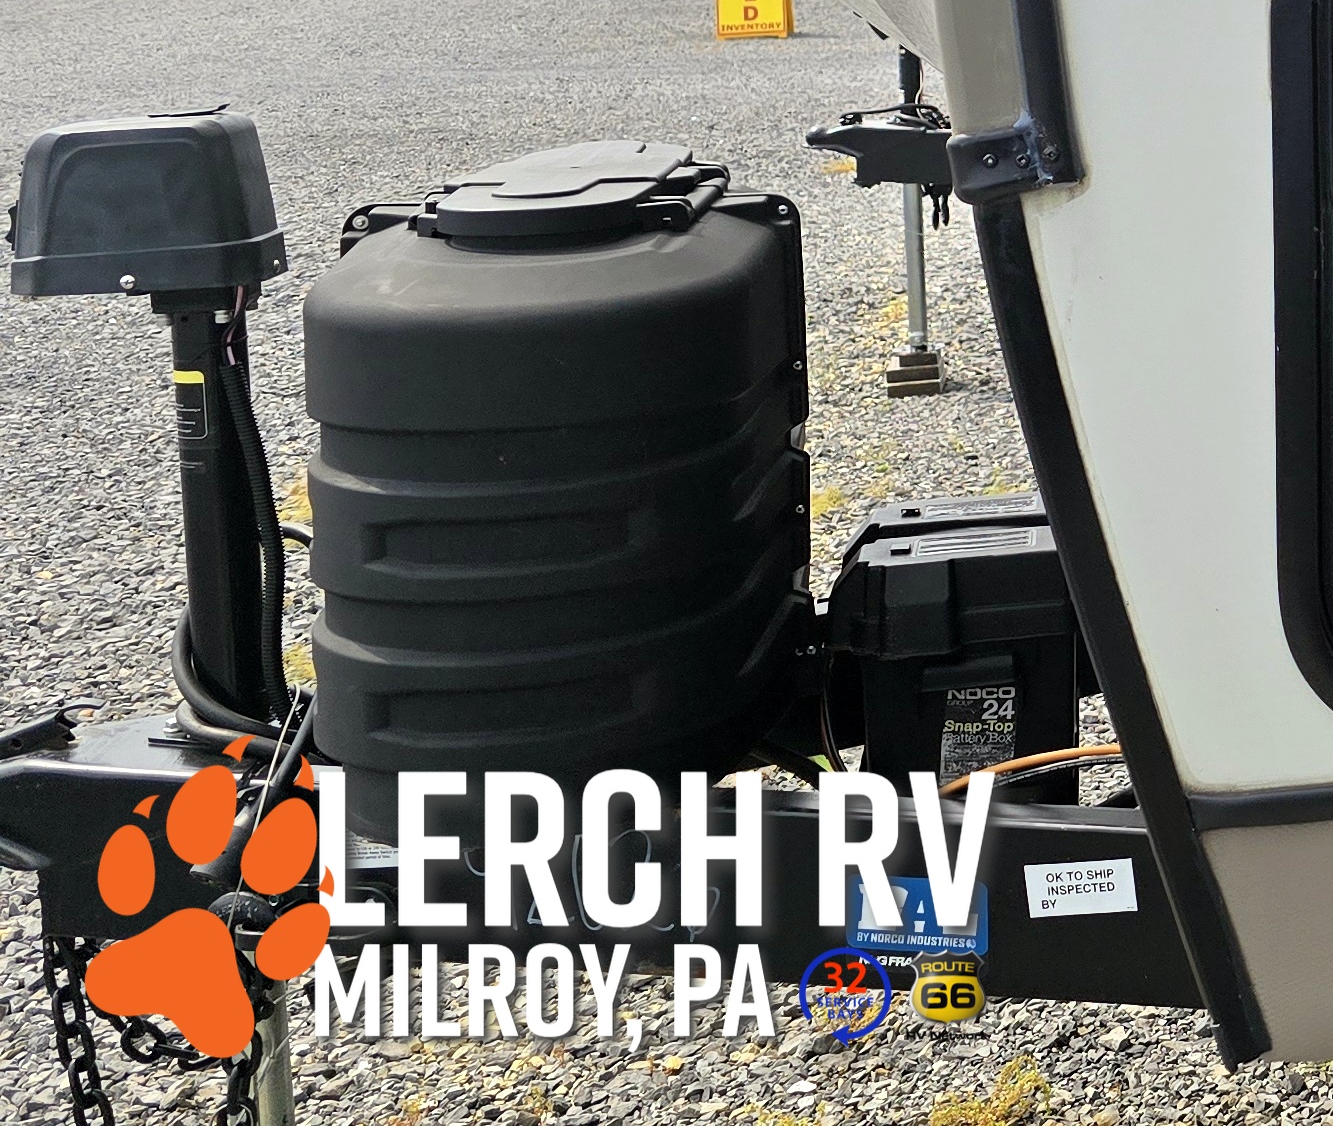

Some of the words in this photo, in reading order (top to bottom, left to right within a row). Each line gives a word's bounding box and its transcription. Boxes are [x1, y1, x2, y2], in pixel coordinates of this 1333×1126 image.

[721, 21, 782, 32] INVENTORY
[947, 686, 1016, 700] NOCO
[981, 699, 1016, 720] 24
[944, 720, 1014, 734] Snap-Top
[989, 733, 1013, 743] Box
[1046, 872, 1064, 883] OK
[1066, 870, 1083, 882] TO
[1086, 868, 1114, 880] SHIP
[1047, 882, 1115, 897] INSPECTED
[1041, 899, 1057, 910] BY
[856, 932, 869, 942] BY
[870, 933, 905, 945] NORCO
[907, 935, 966, 948] INDUSTRIES
